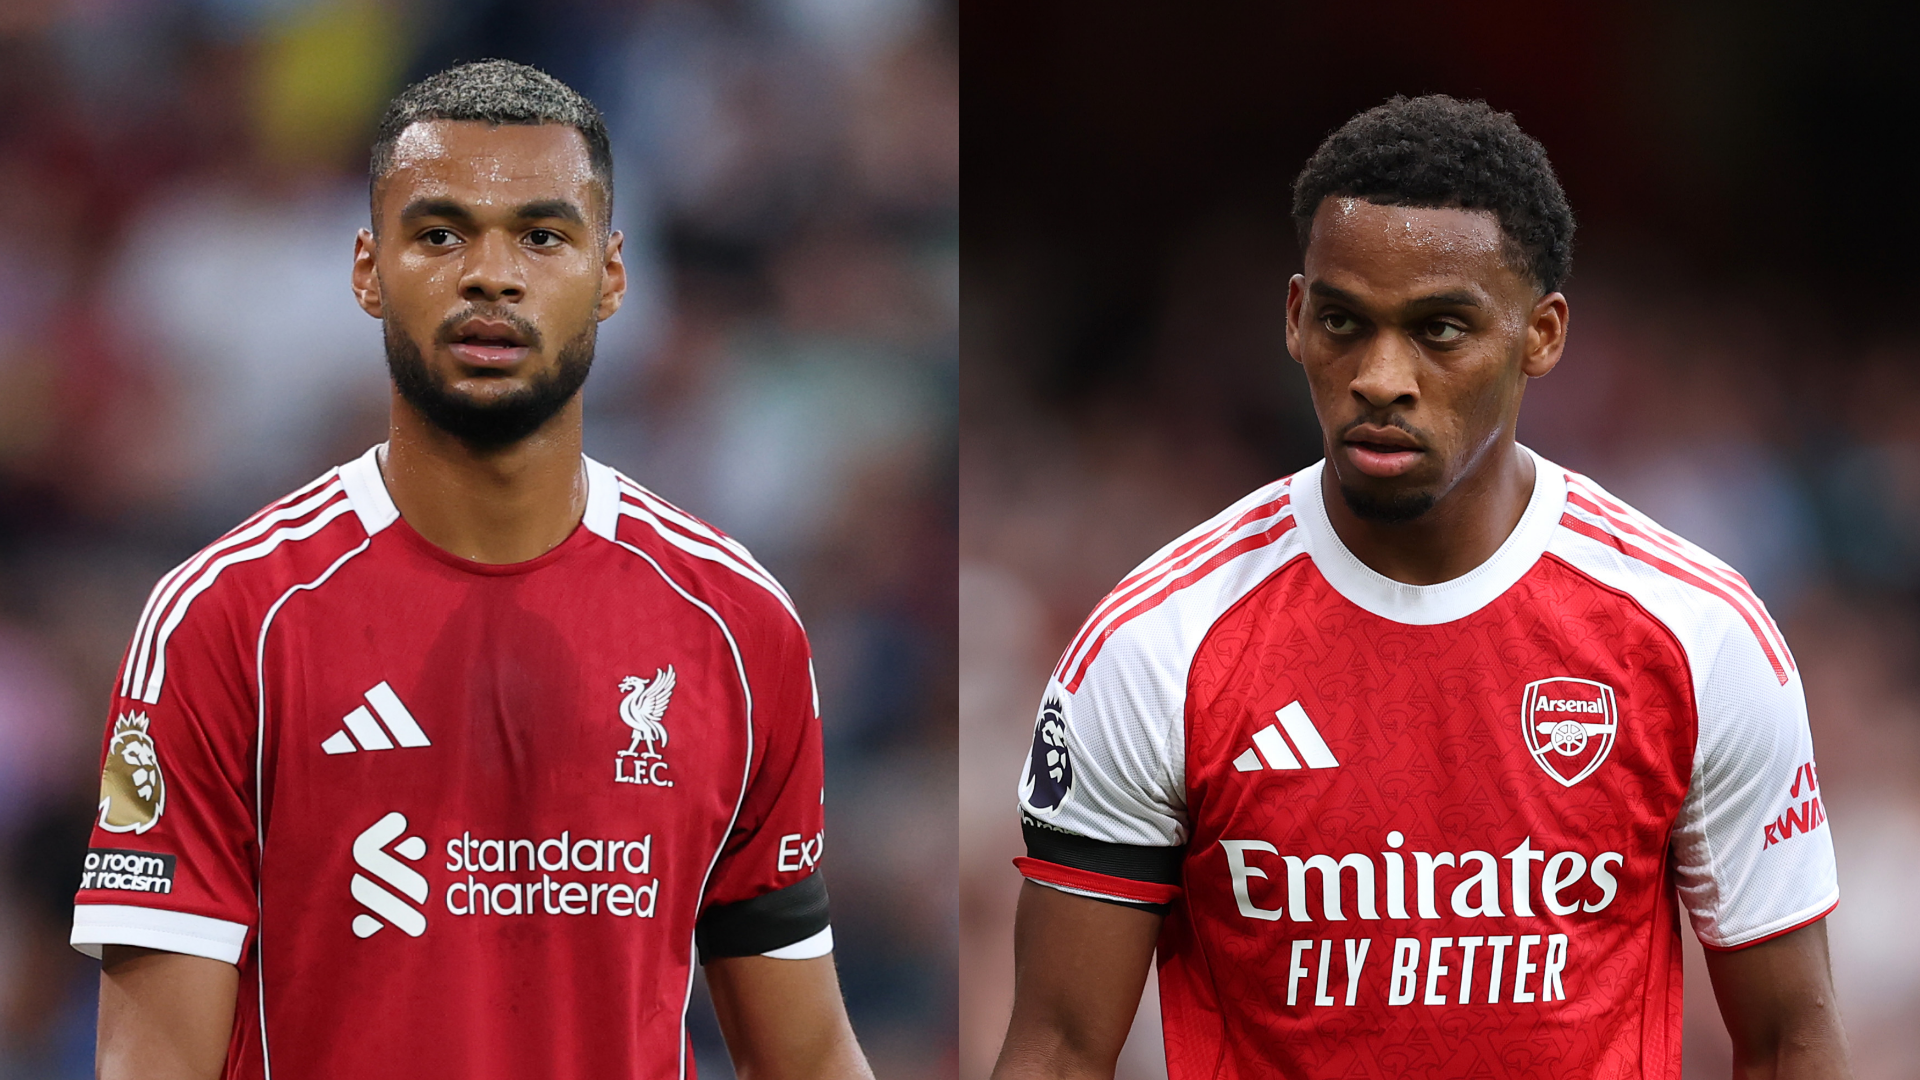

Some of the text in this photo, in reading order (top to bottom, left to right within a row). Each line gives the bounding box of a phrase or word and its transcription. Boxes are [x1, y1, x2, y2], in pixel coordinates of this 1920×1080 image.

[1535, 695, 1604, 714] Arsenal
[614, 758, 674, 787] L.F.C.
[1789, 760, 1819, 799] VI
[1762, 797, 1826, 852] RWA
[84, 852, 165, 876] o room
[446, 830, 652, 875] standard
[96, 871, 172, 894] racism
[446, 873, 660, 919] chartered
[1218, 830, 1625, 922] Emirates
[1286, 933, 1569, 1007] FLY BETTER
